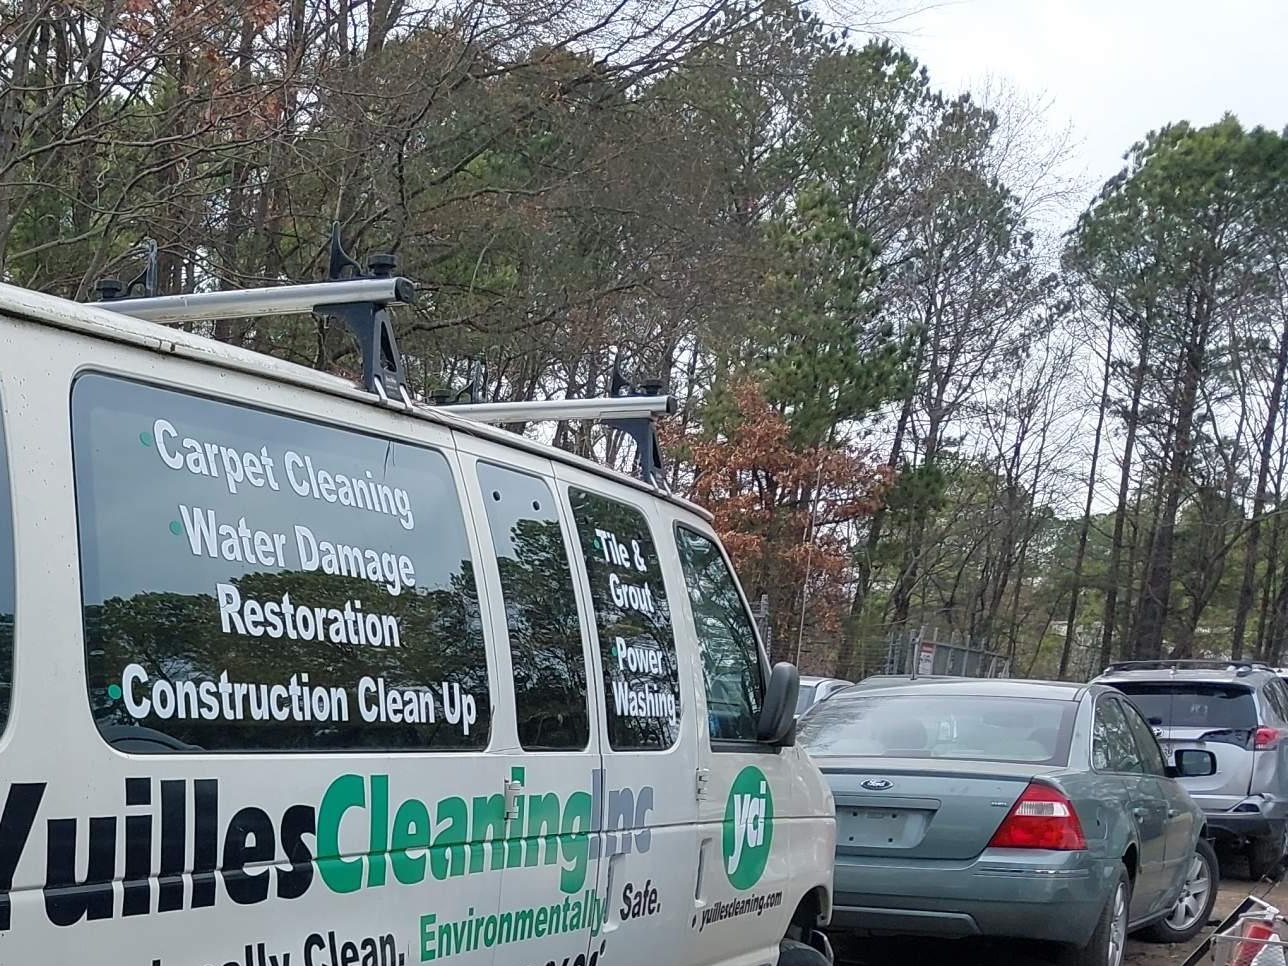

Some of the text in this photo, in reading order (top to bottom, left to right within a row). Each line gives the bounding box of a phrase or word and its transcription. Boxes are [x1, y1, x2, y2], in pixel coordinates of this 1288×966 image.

[153, 419, 414, 530] Carpet Cleaning
[179, 504, 415, 596] Water Damage
[594, 528, 647, 572] Tile &
[217, 583, 400, 647] Restoration
[609, 573, 654, 613] Grout
[616, 636, 663, 674] Power
[122, 664, 476, 735] Construction Clean Up
[613, 681, 676, 726] Washing
[728, 781, 767, 875] yci
[420, 889, 605, 962] Environmentally
[620, 879, 661, 921] Safe.
[699, 890, 782, 933] yuillescleaning.com
